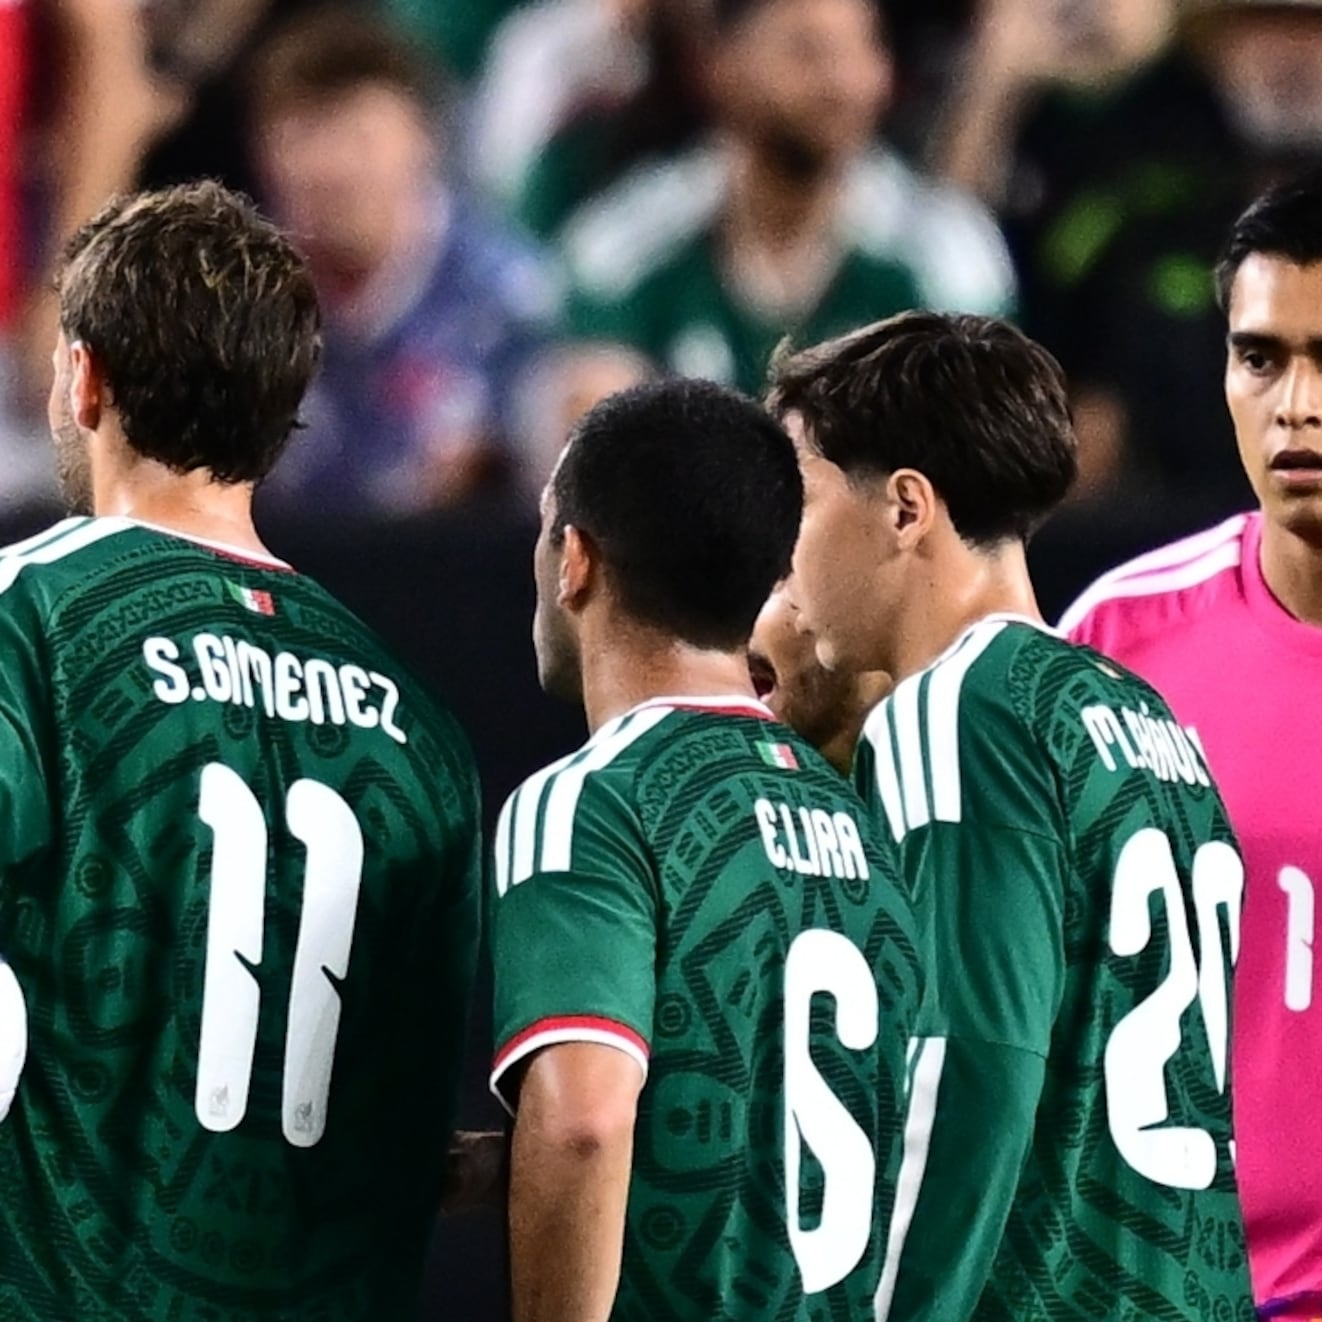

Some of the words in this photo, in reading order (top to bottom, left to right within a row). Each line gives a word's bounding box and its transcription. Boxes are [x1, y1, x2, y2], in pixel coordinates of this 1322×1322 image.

[143, 633, 408, 745] S.GIMENEZ
[754, 798, 870, 881] E.LIRA
[195, 761, 364, 1148] 11
[1277, 865, 1315, 1013] 1
[784, 927, 879, 1294] 6
